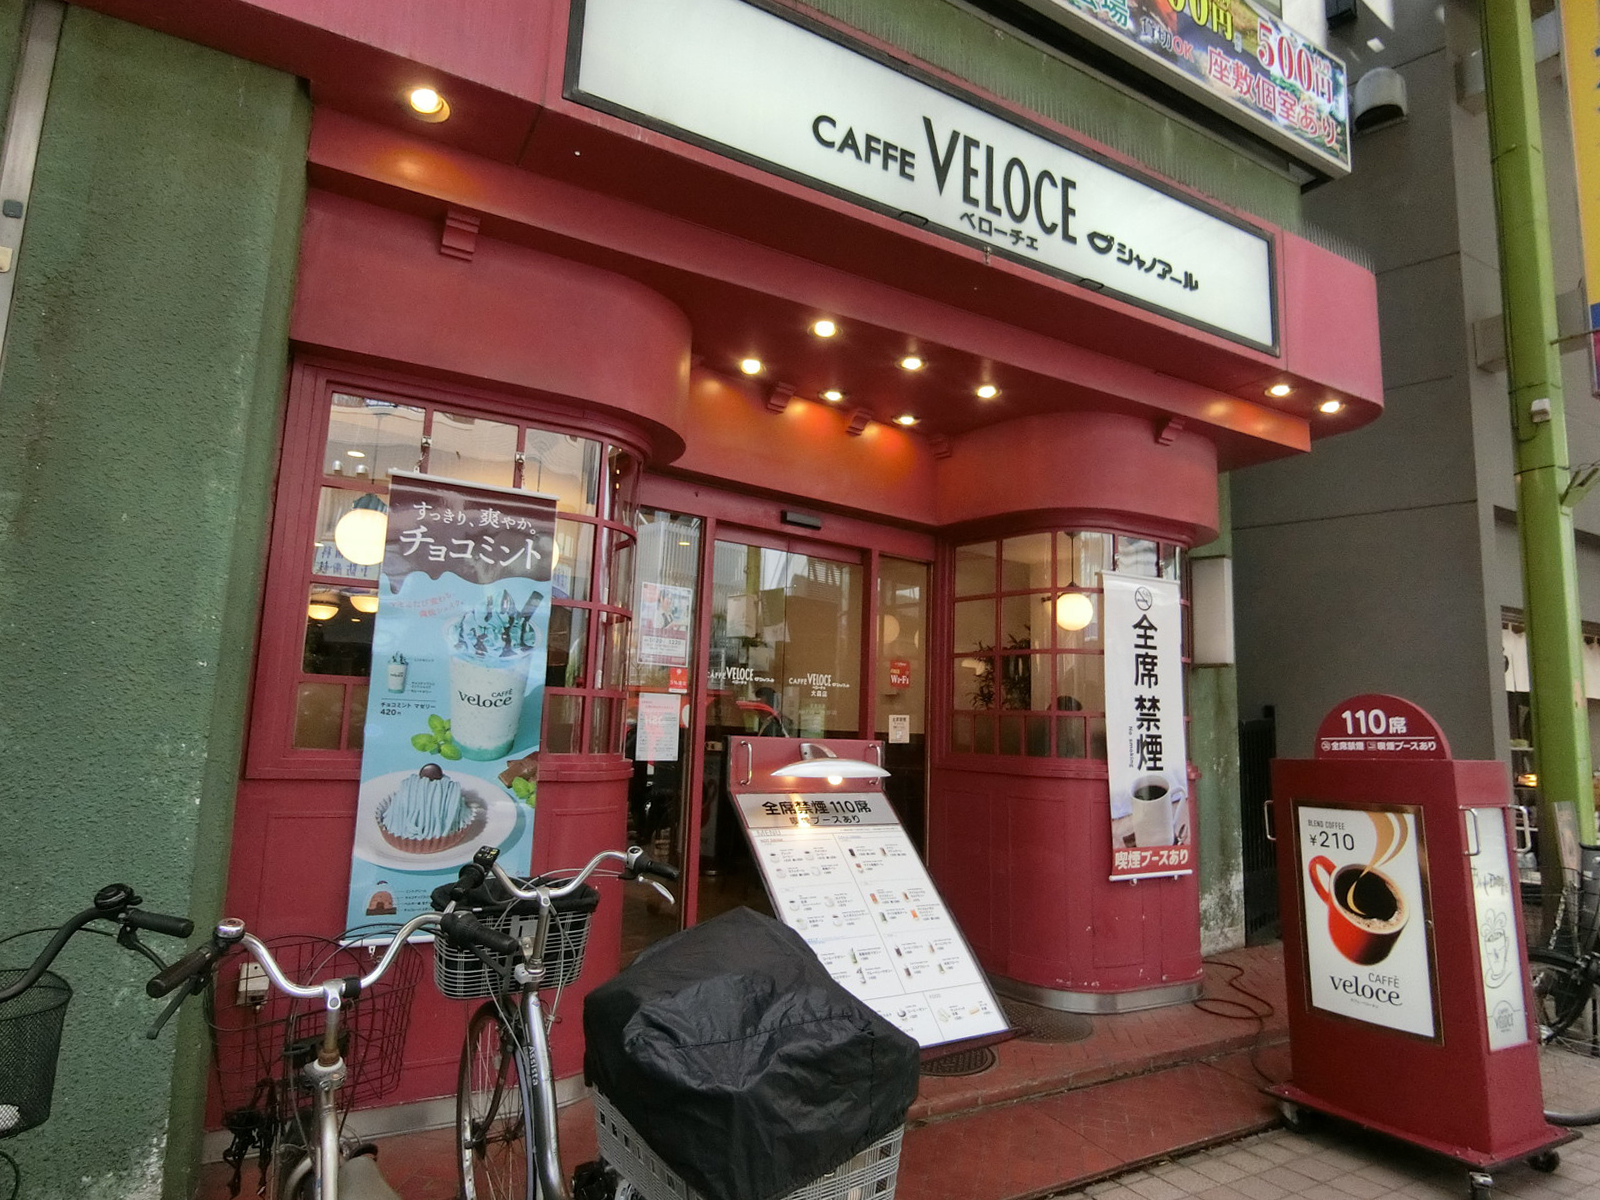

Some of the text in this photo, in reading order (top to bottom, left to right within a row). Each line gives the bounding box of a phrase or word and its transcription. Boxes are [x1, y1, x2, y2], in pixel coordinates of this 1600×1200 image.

[1207, 46, 1337, 146] 座敷個室あり
[812, 115, 1077, 244] CAFFE VELOCE
[960, 212, 1038, 250] ベローチェ
[1116, 242, 1199, 291] シャノアール
[414, 501, 537, 535] すっきり、爽やか。
[399, 525, 542, 569] チョコミント
[726, 666, 754, 682] VELOCE
[789, 677, 807, 686] CAFFE
[807, 673, 831, 687] VELOCE
[458, 690, 513, 709] veloce
[1131, 614, 1164, 771] 全席禁煙
[1341, 708, 1407, 735] 110席
[1309, 831, 1354, 850] ¥210
[1114, 848, 1190, 871] 喫煙ブースあり
[1329, 974, 1403, 1006] veloce
